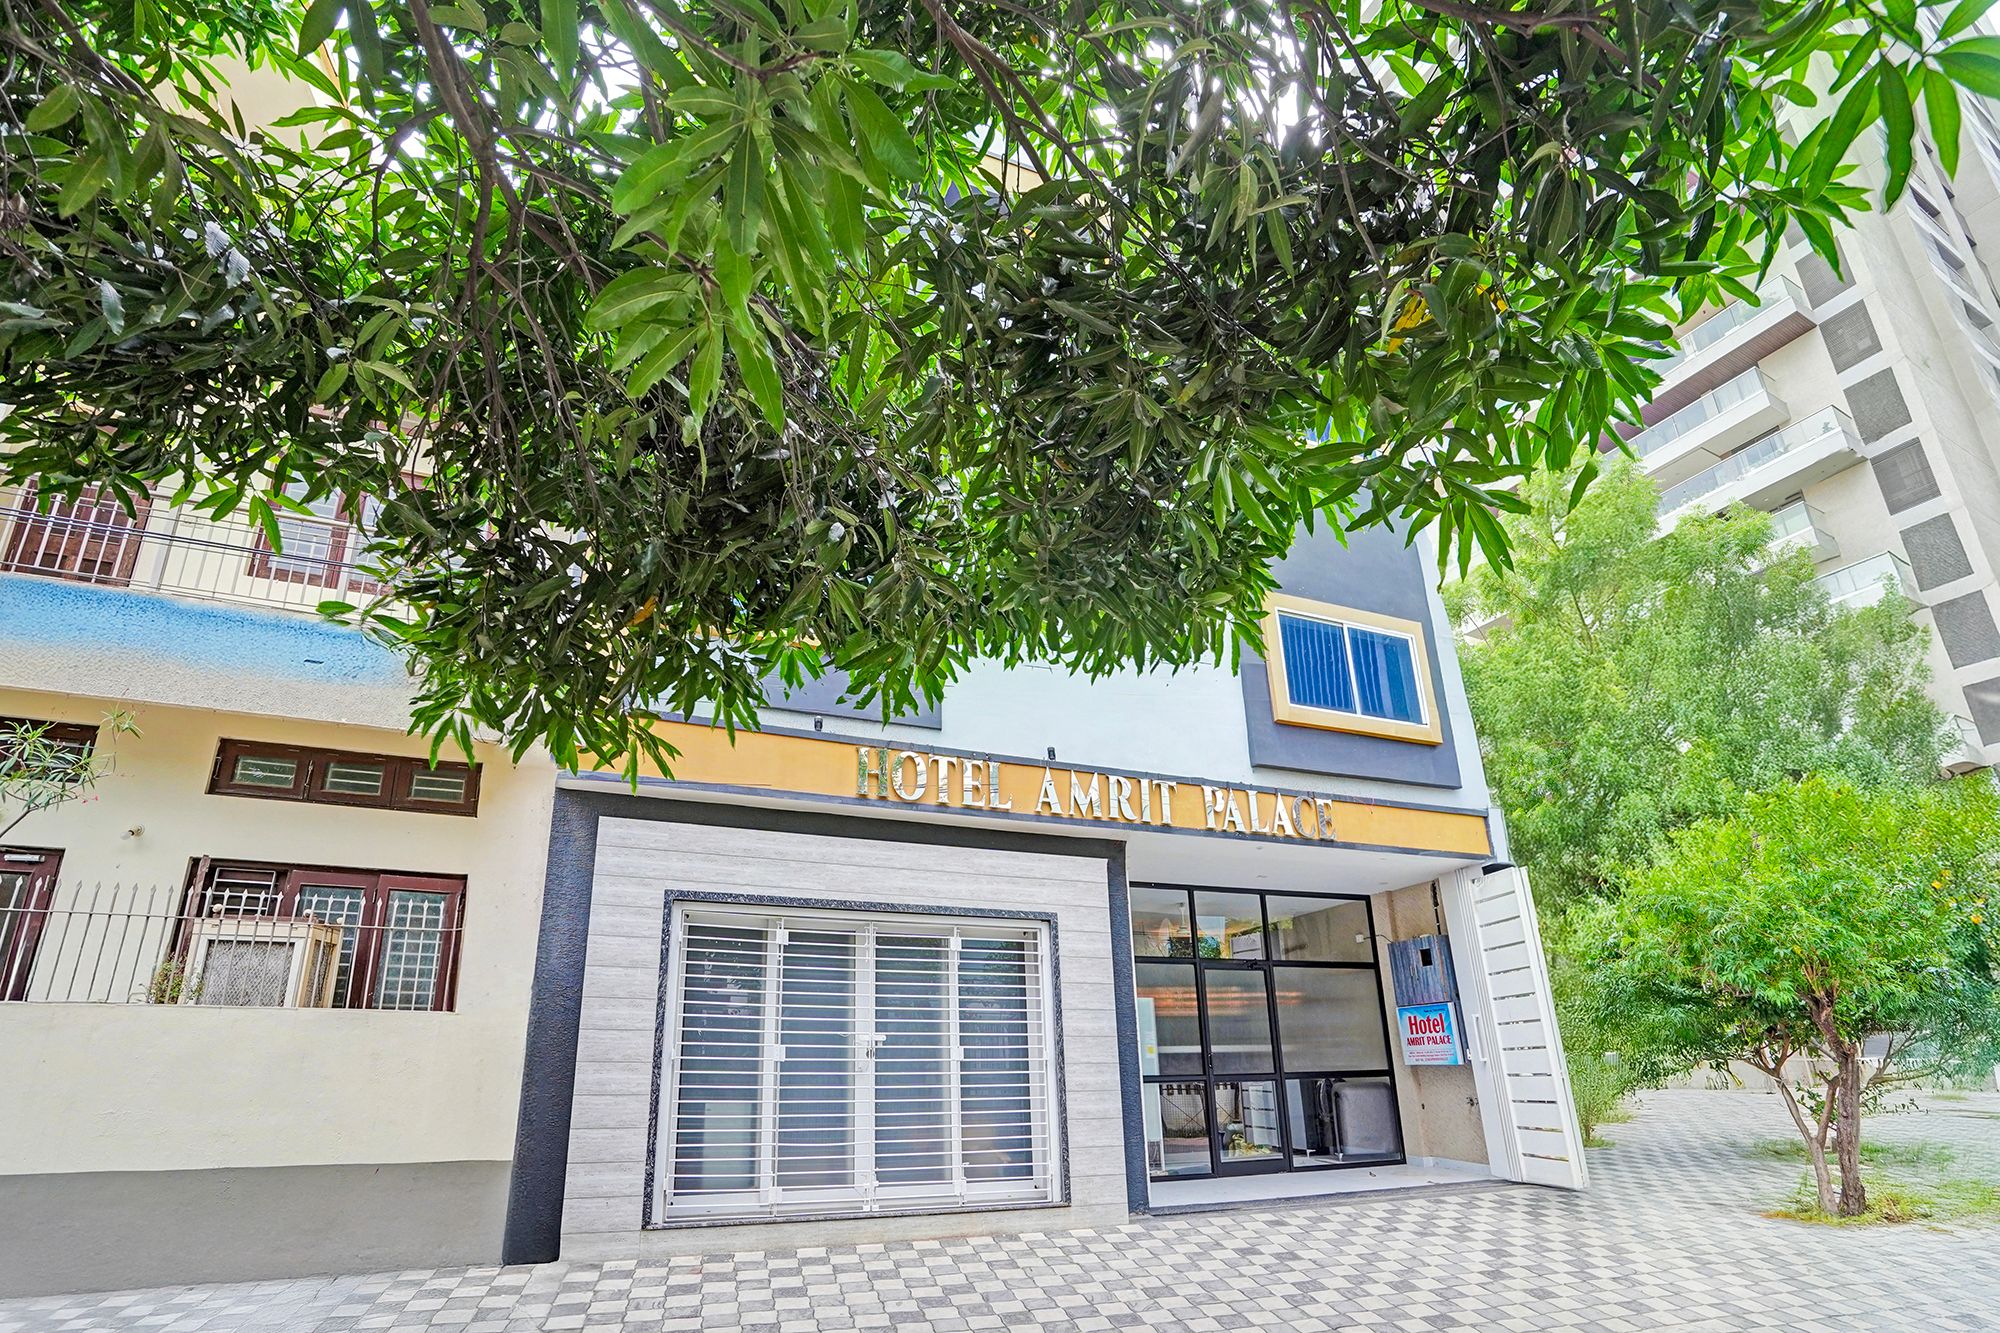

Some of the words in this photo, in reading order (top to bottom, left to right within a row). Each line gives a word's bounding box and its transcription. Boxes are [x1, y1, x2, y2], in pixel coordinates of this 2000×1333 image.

[856, 747, 1012, 809] HOTEL
[1035, 766, 1177, 825] AMRIT
[1202, 785, 1337, 841] PALACE
[1408, 1013, 1445, 1035] Hotel
[1407, 1036, 1425, 1046] AMRIT
[1427, 1035, 1452, 1045] PALACE
